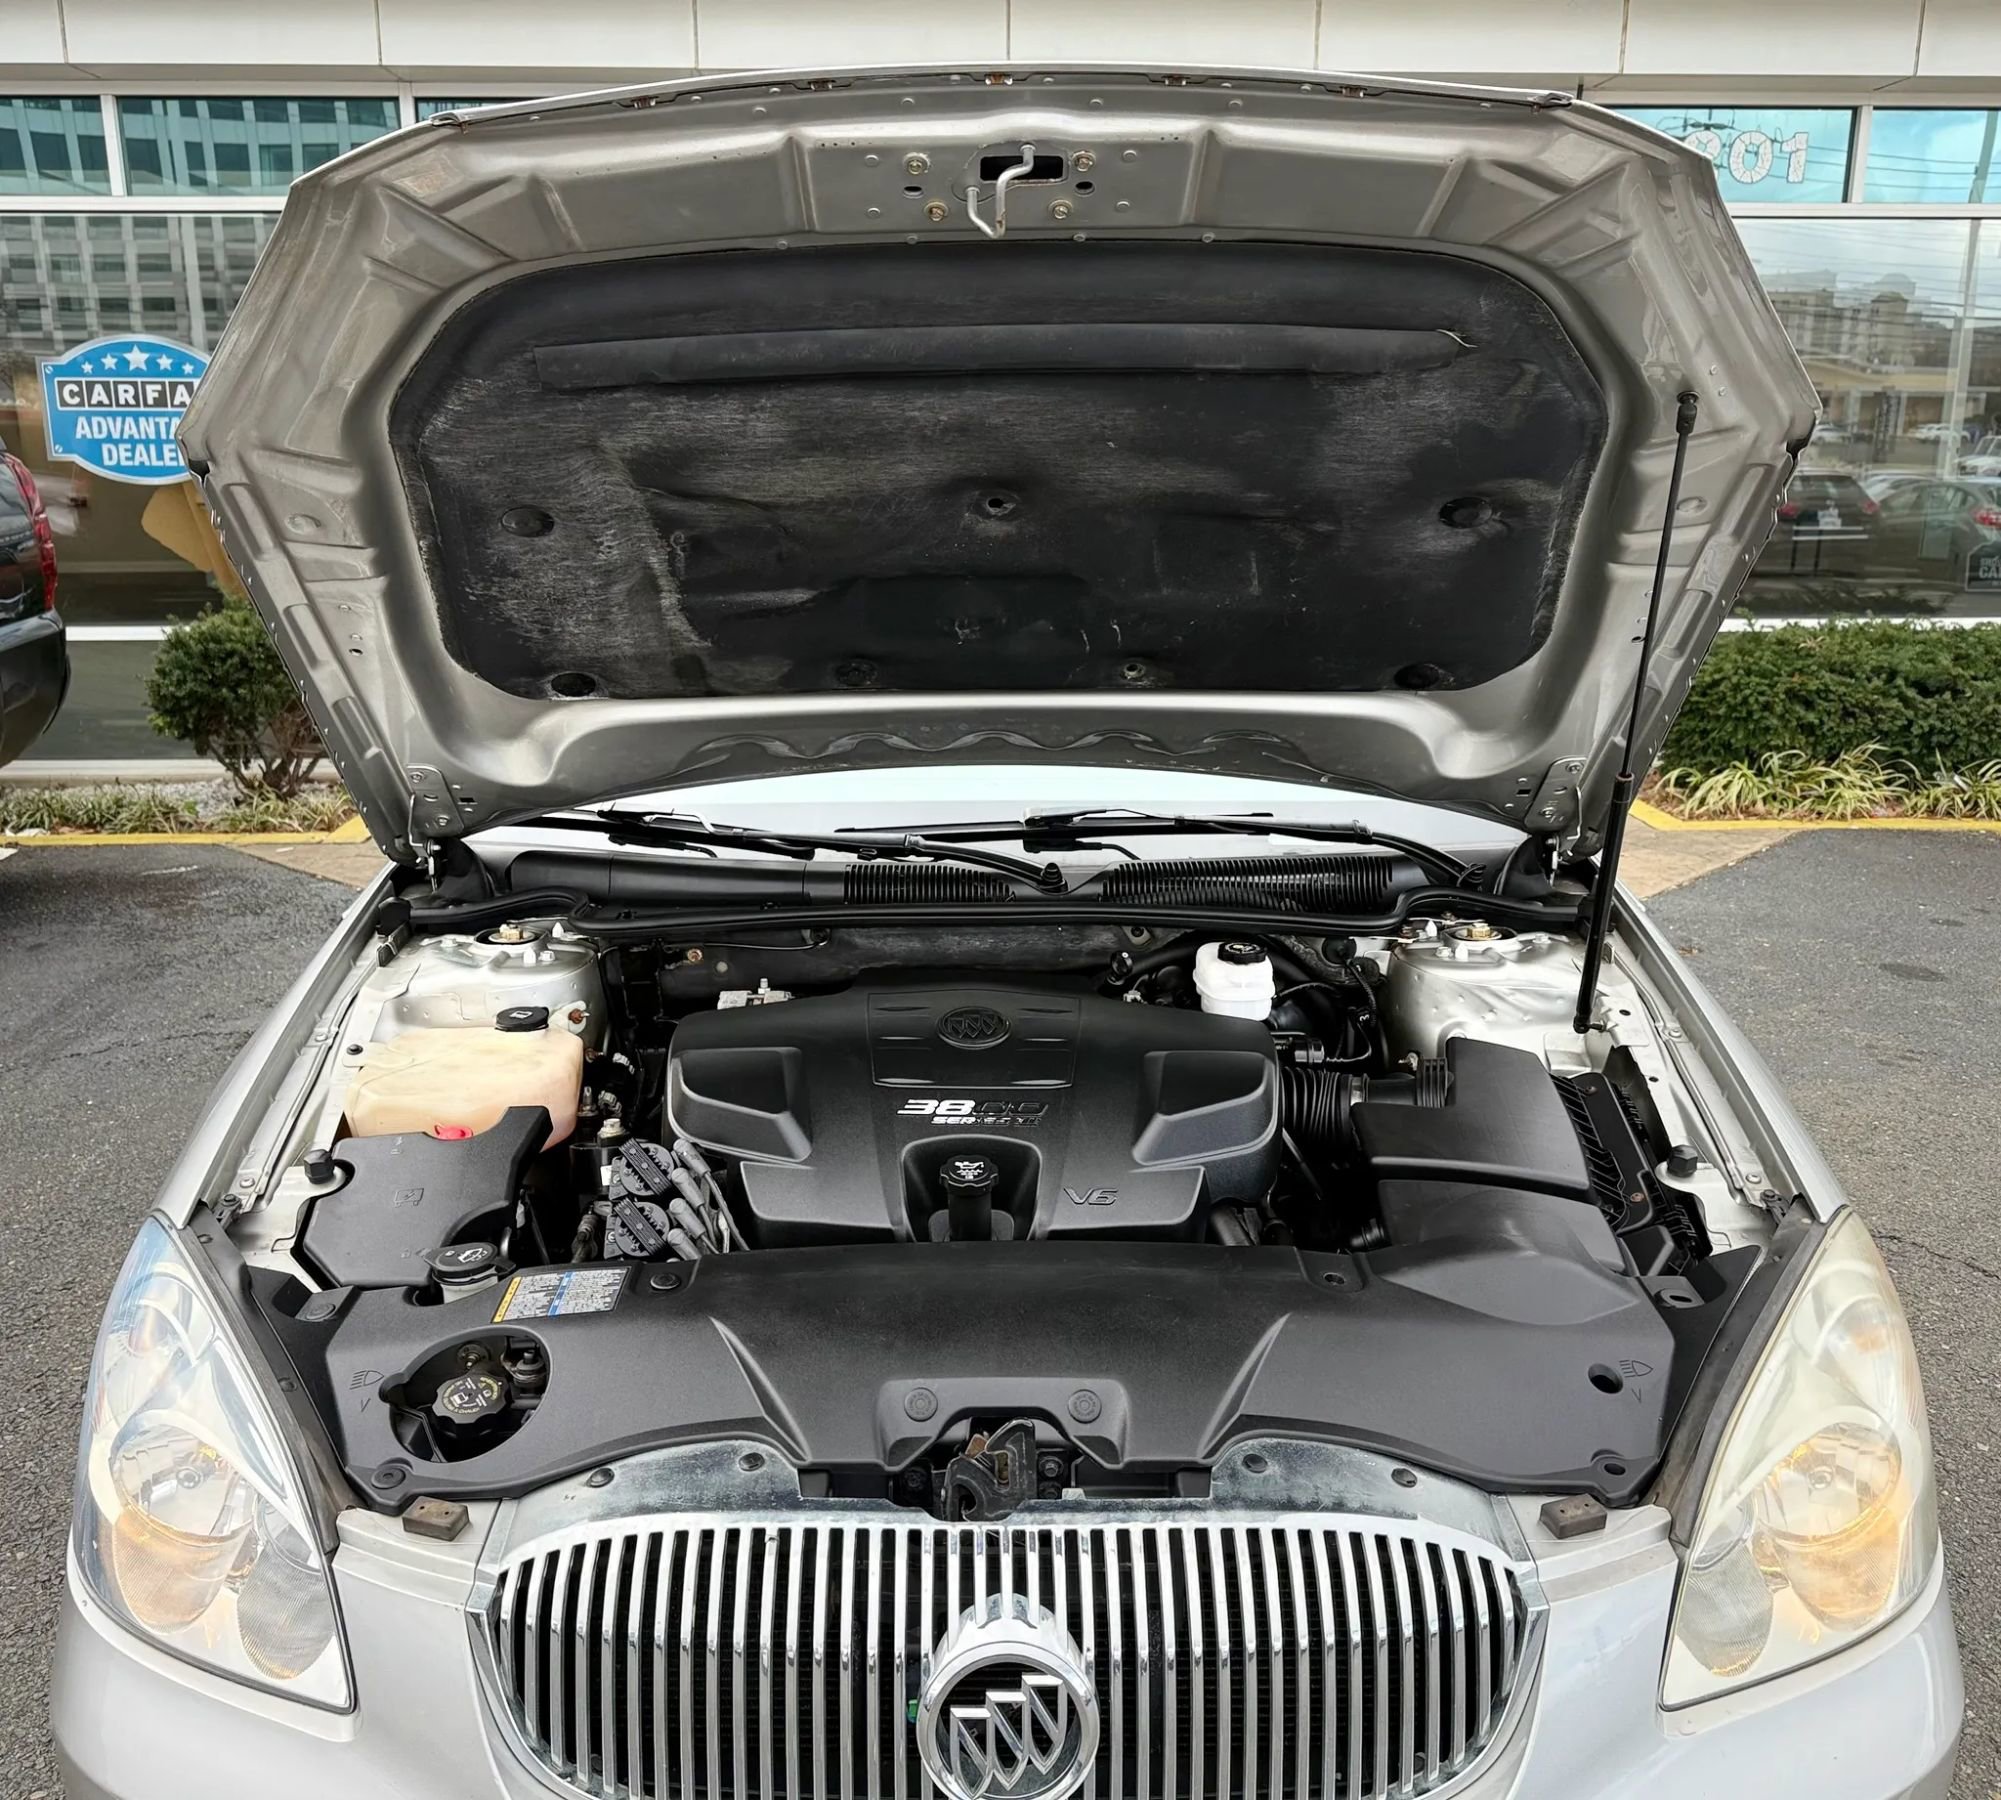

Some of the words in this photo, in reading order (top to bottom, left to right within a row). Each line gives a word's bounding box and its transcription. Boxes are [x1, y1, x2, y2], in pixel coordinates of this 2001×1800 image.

[62, 383, 191, 406] CARFA
[75, 416, 181, 440] ADVANTA
[1063, 1187, 1119, 1206] V6
